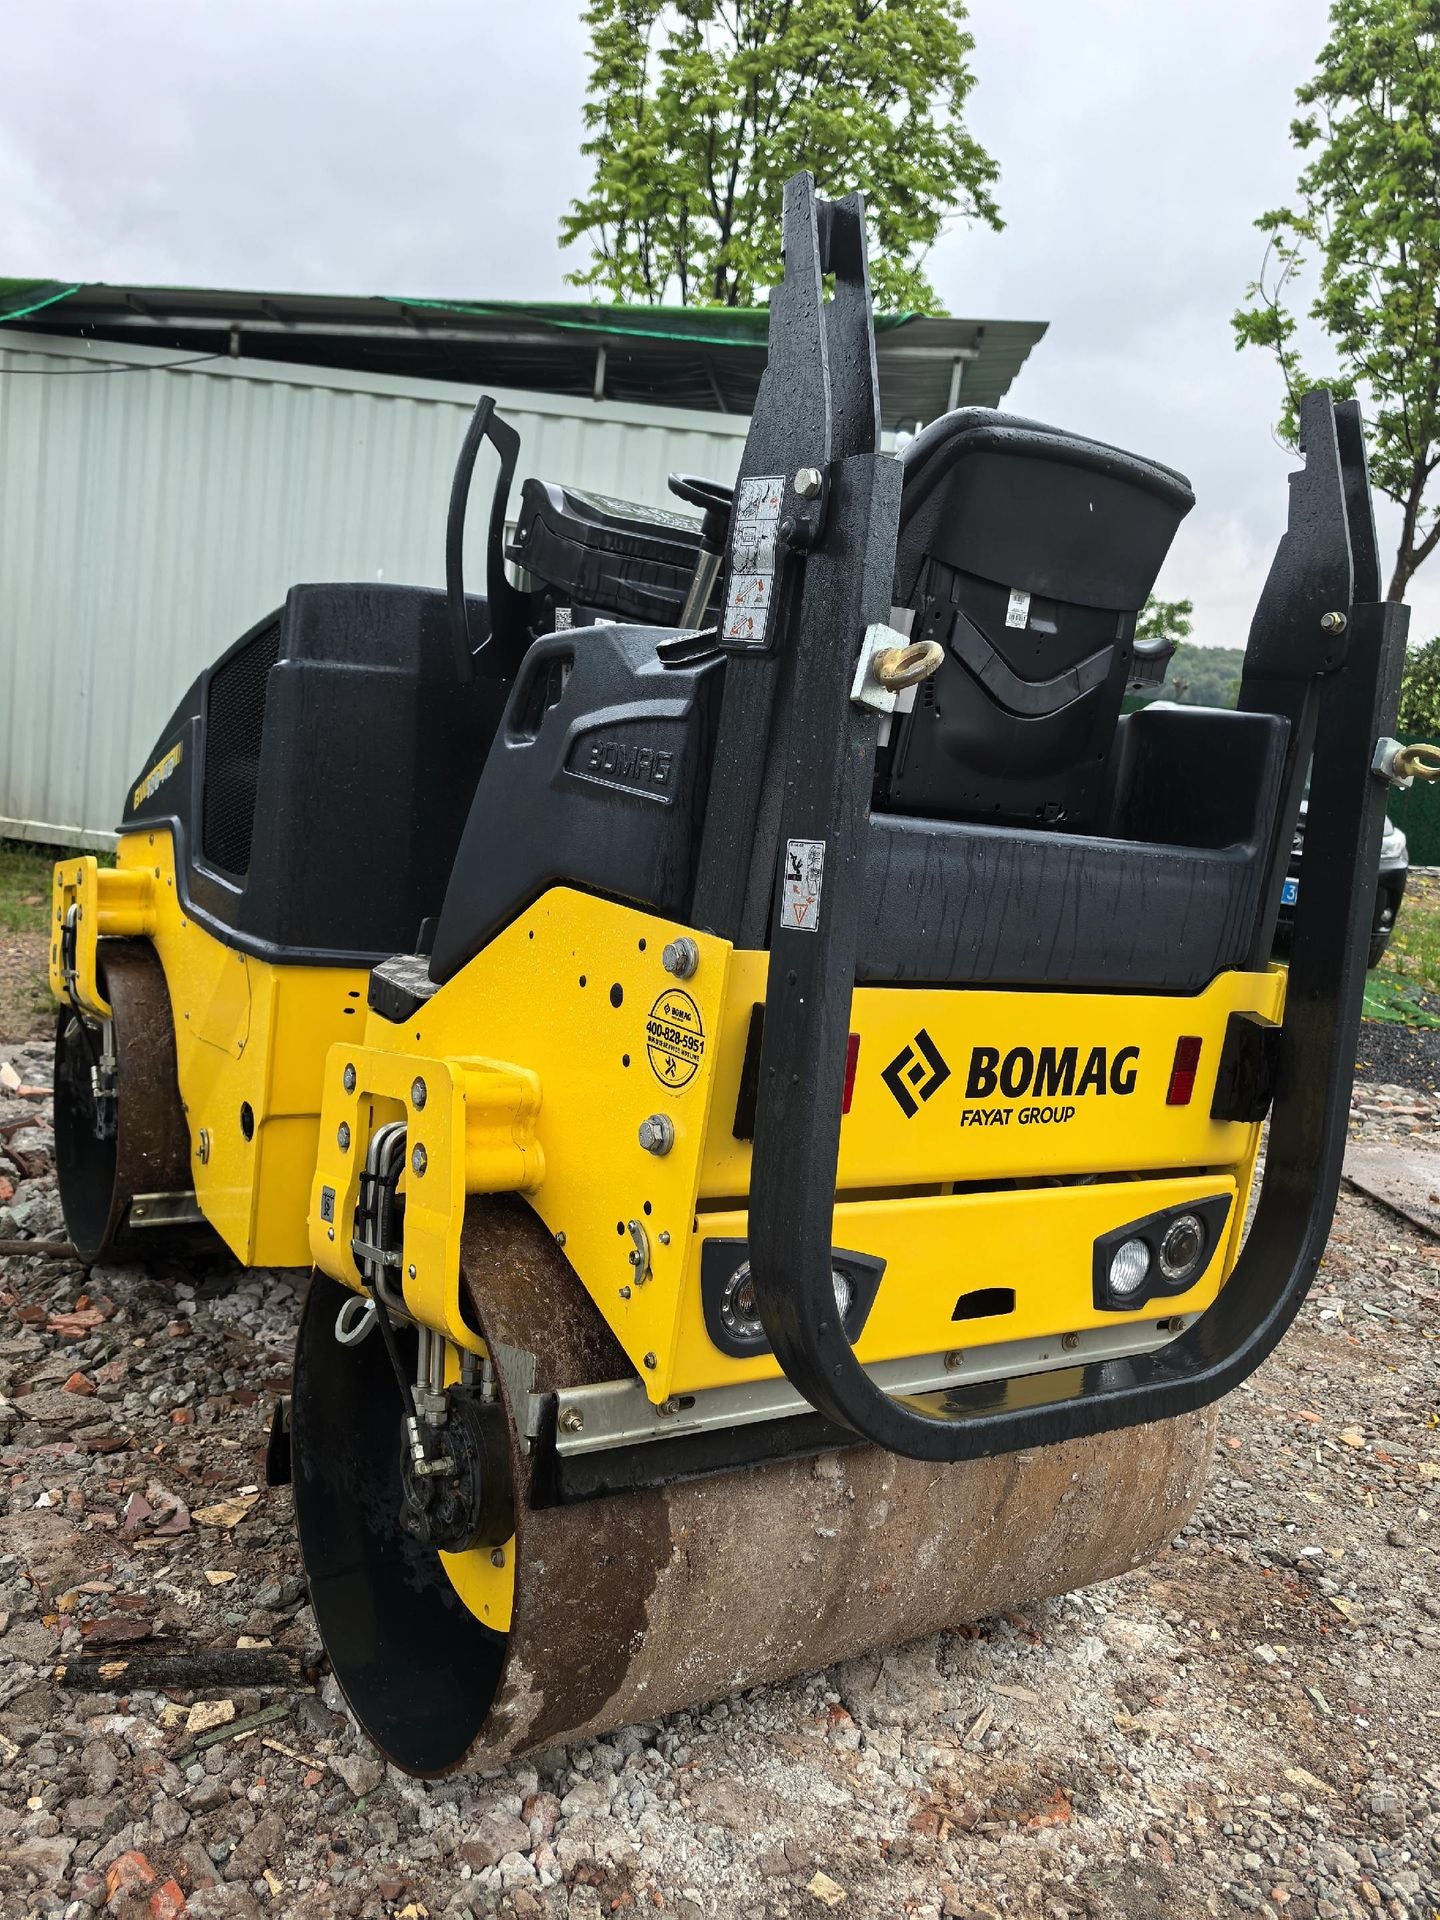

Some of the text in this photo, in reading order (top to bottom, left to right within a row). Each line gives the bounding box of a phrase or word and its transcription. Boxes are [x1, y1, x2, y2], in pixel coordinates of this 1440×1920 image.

[587, 740, 672, 785] BOMAG
[671, 1007, 691, 1021] BOMAG
[646, 1020, 705, 1055] 400-828-5951
[965, 1045, 1140, 1099] BOMAG
[960, 1105, 1076, 1127] FAYAT GROUP
